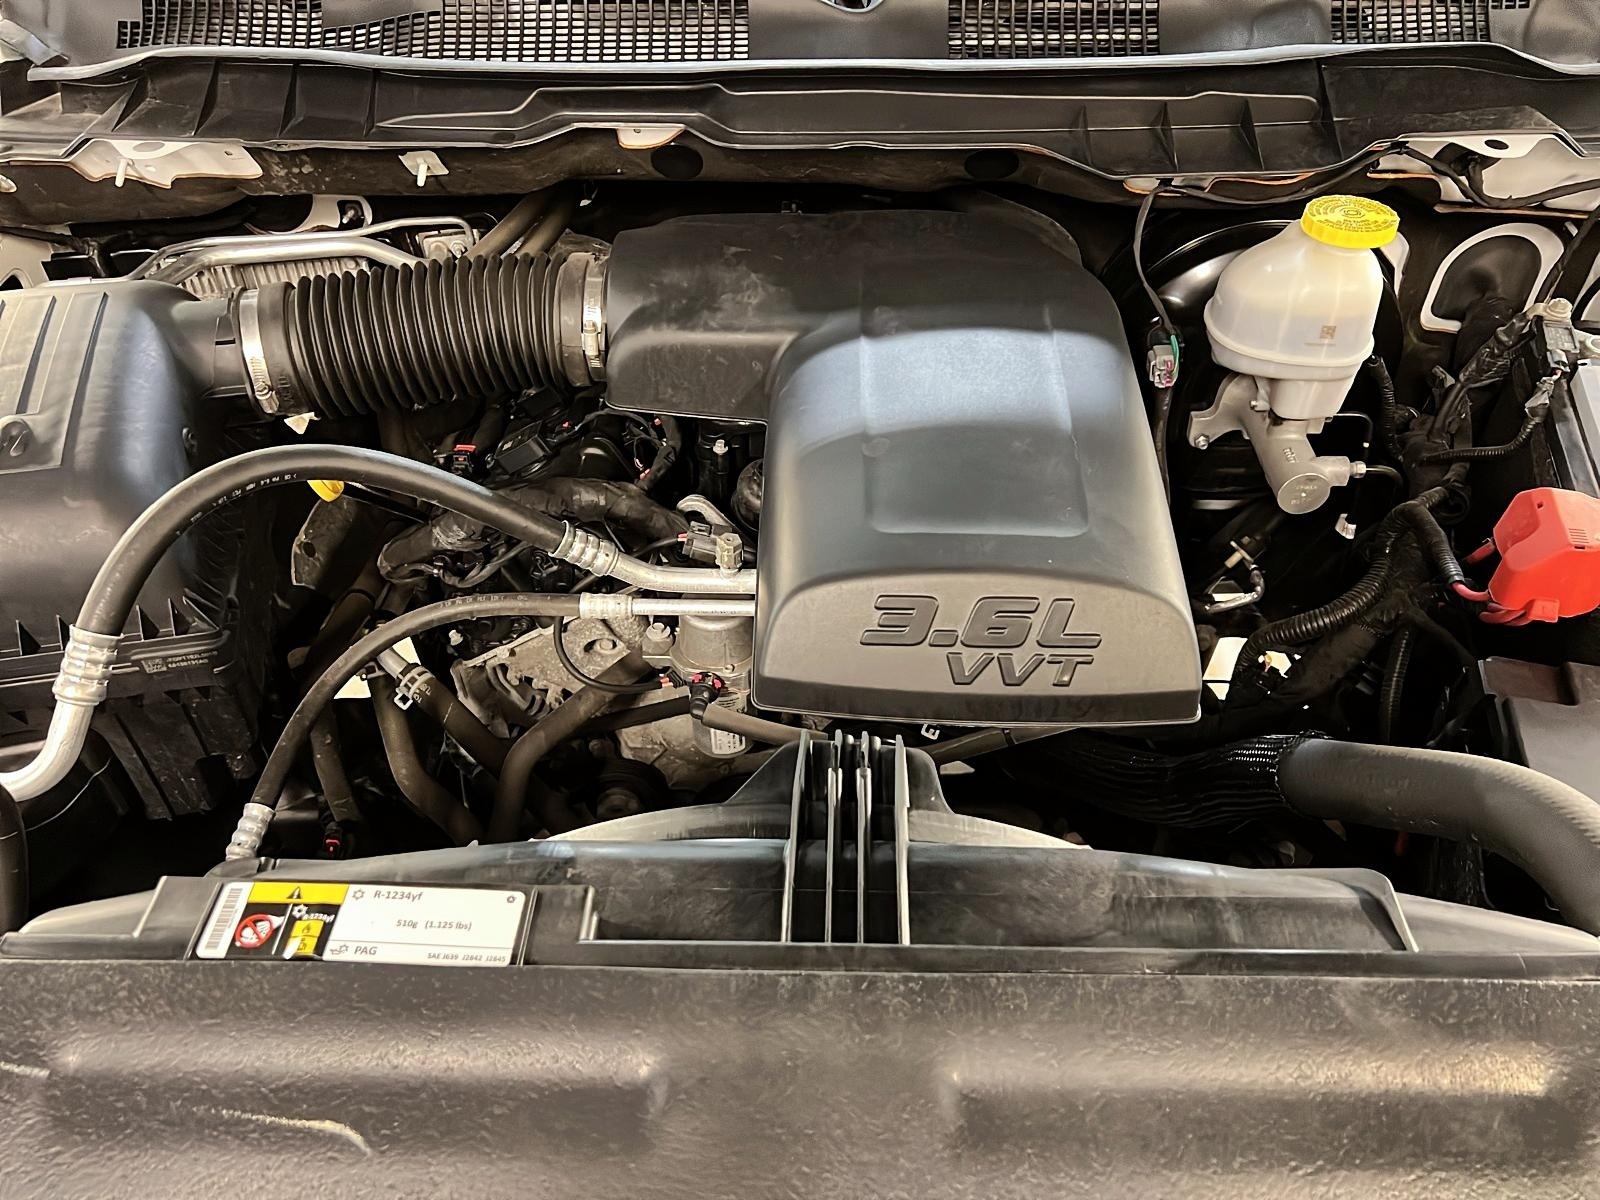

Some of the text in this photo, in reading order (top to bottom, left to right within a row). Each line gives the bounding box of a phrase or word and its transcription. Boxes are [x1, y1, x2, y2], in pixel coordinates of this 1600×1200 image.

[860, 593, 1102, 648] 3.6L
[946, 652, 1095, 687] VVT
[374, 890, 424, 902] R-1234yf
[396, 919, 472, 931] 510g (1.125 lbs)
[354, 945, 378, 956] PAG
[427, 952, 441, 961] SAE
[442, 953, 459, 961] J639
